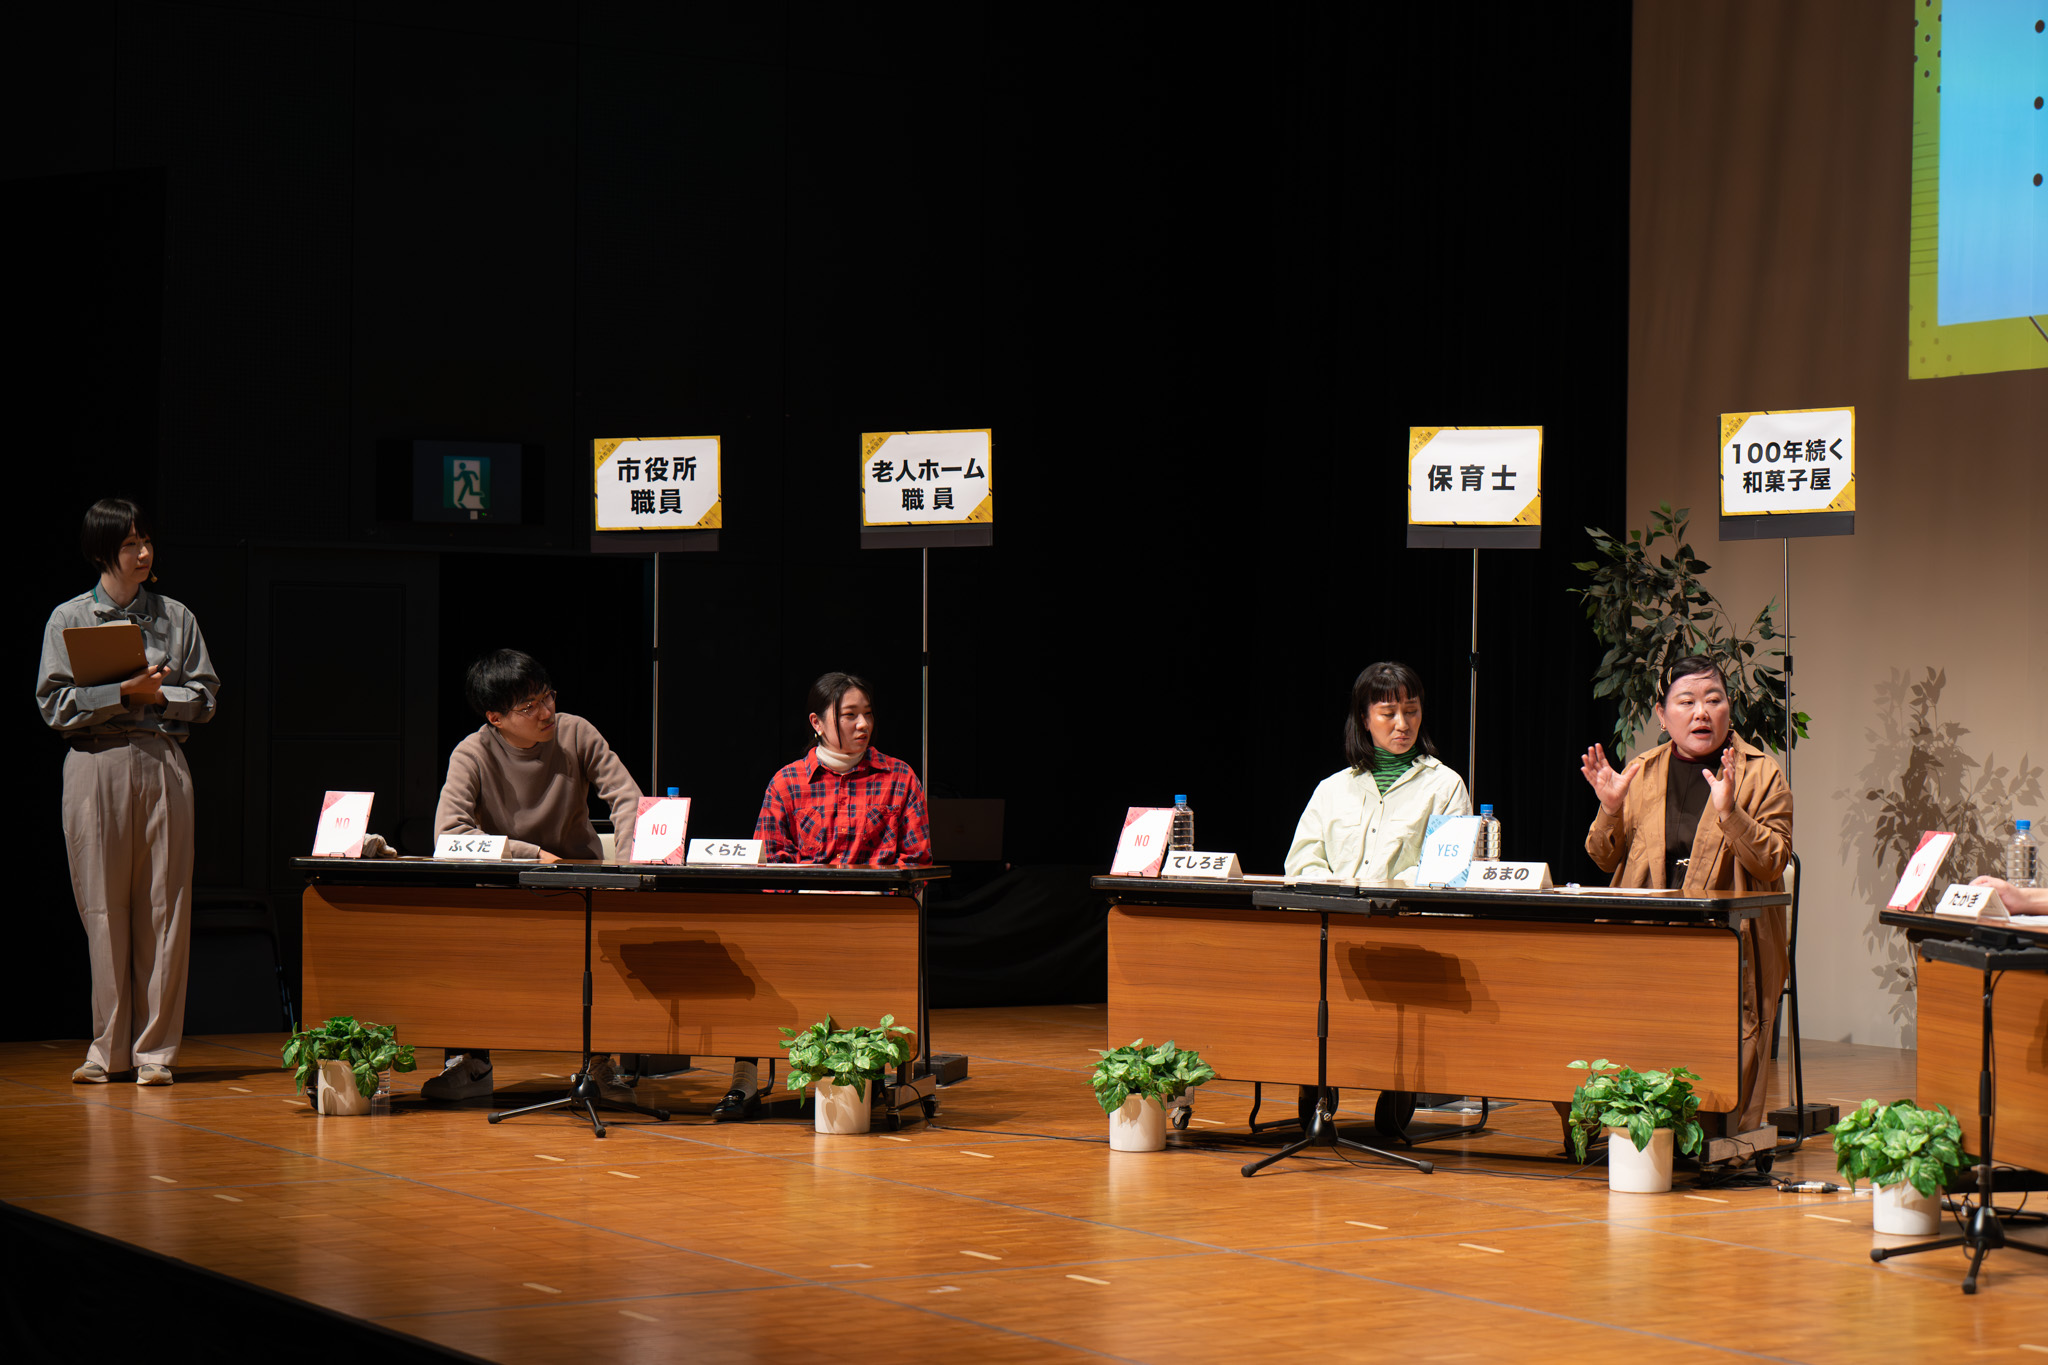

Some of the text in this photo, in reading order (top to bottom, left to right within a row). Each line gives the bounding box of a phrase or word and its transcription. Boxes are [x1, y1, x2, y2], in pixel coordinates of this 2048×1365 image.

[1731, 437, 1843, 465] 100年続く
[617, 455, 697, 483] 市役所
[872, 457, 985, 483] 老人ホーム
[1427, 464, 1517, 492] 保育士
[1742, 467, 1831, 494] 和菓子屋
[630, 488, 683, 515] 職員
[901, 486, 955, 512] 職員
[335, 816, 351, 830] NO
[650, 823, 668, 836] NO
[448, 839, 493, 854] ふくだ
[703, 842, 747, 856] くらた
[1133, 834, 1151, 848] NO
[1437, 843, 1460, 857] YES
[1173, 855, 1228, 871] てしろぎ
[1482, 865, 1530, 881] あまの
[1948, 890, 1981, 907] たかぎ
